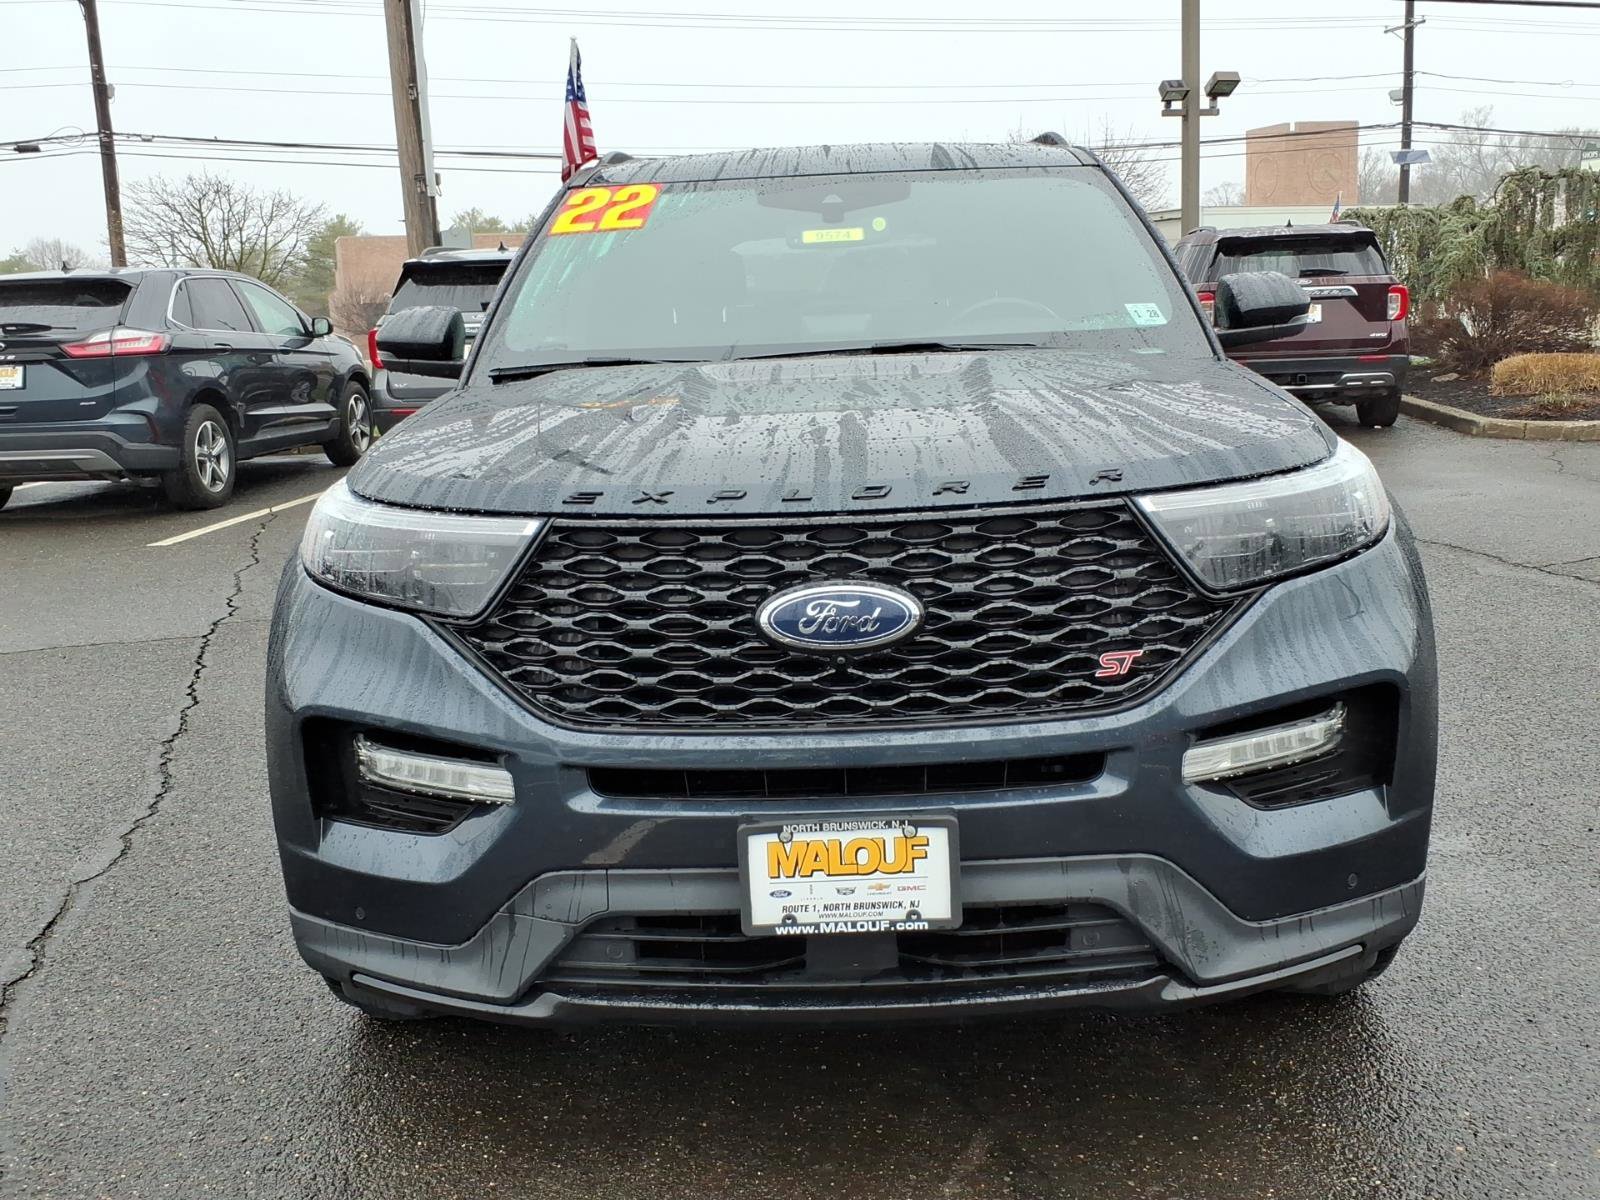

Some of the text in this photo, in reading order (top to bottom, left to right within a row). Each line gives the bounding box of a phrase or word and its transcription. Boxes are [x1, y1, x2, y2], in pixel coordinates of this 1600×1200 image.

[551, 184, 657, 234] 22
[562, 468, 1123, 504] EXPLORER
[799, 600, 882, 634] Ford
[1095, 650, 1143, 677] ST
[783, 823, 820, 834] NORTH
[823, 820, 889, 832] BRUNSWICK,
[767, 836, 929, 879] MALOUF
[782, 900, 920, 914] ROUTE 1, NORTH BRUNSWICK, NJ
[819, 911, 884, 919] WWW.MALOUF.COM
[775, 920, 929, 935] www.MALOUF.com
